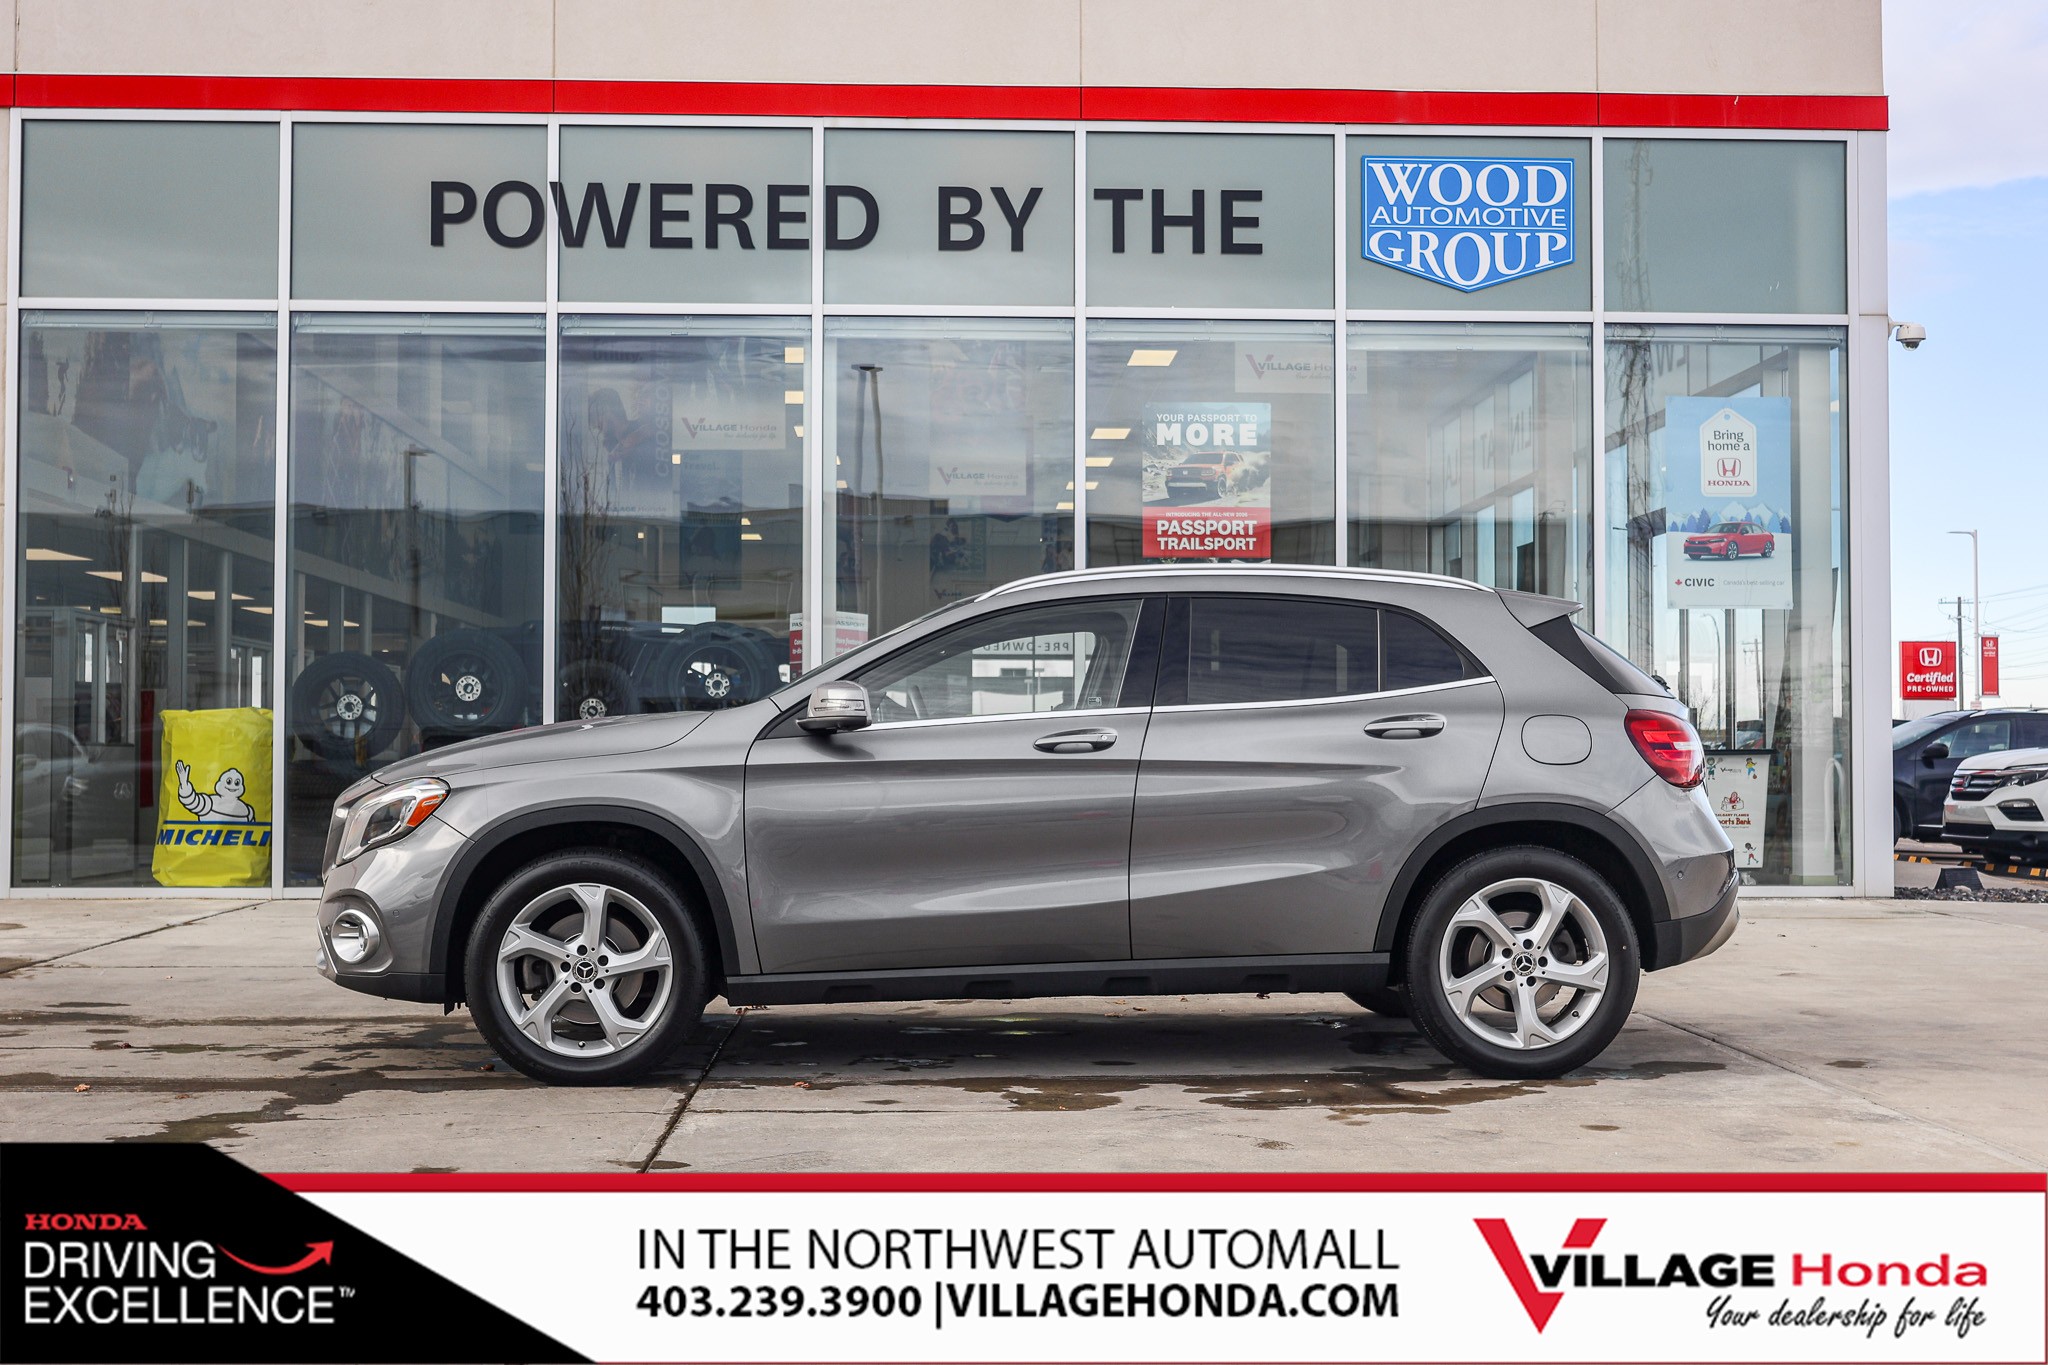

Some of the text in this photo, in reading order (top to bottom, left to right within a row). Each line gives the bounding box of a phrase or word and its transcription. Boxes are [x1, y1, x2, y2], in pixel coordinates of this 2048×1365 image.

[1367, 163, 1567, 207] WOOD
[430, 180, 1263, 256] POWERED BY THE
[1371, 206, 1566, 226] AUTOMOTIVE
[1369, 230, 1567, 286] GROUP
[1258, 362, 1311, 371] VILLAGE
[1156, 413, 1257, 422] YOUR PASSPORT TO
[691, 424, 738, 432] VILLAGE
[1156, 422, 1258, 446] MORE
[1713, 430, 1744, 443] Bring
[1707, 440, 1750, 451] home a
[946, 472, 985, 480] VILLAGE
[1156, 520, 1258, 535] PASSPORT
[1156, 538, 1257, 550] TRAILSPORT
[1684, 578, 1715, 587] CIVIC
[1906, 671, 1954, 685] Certified
[1906, 685, 1954, 693] PRE-OWNED
